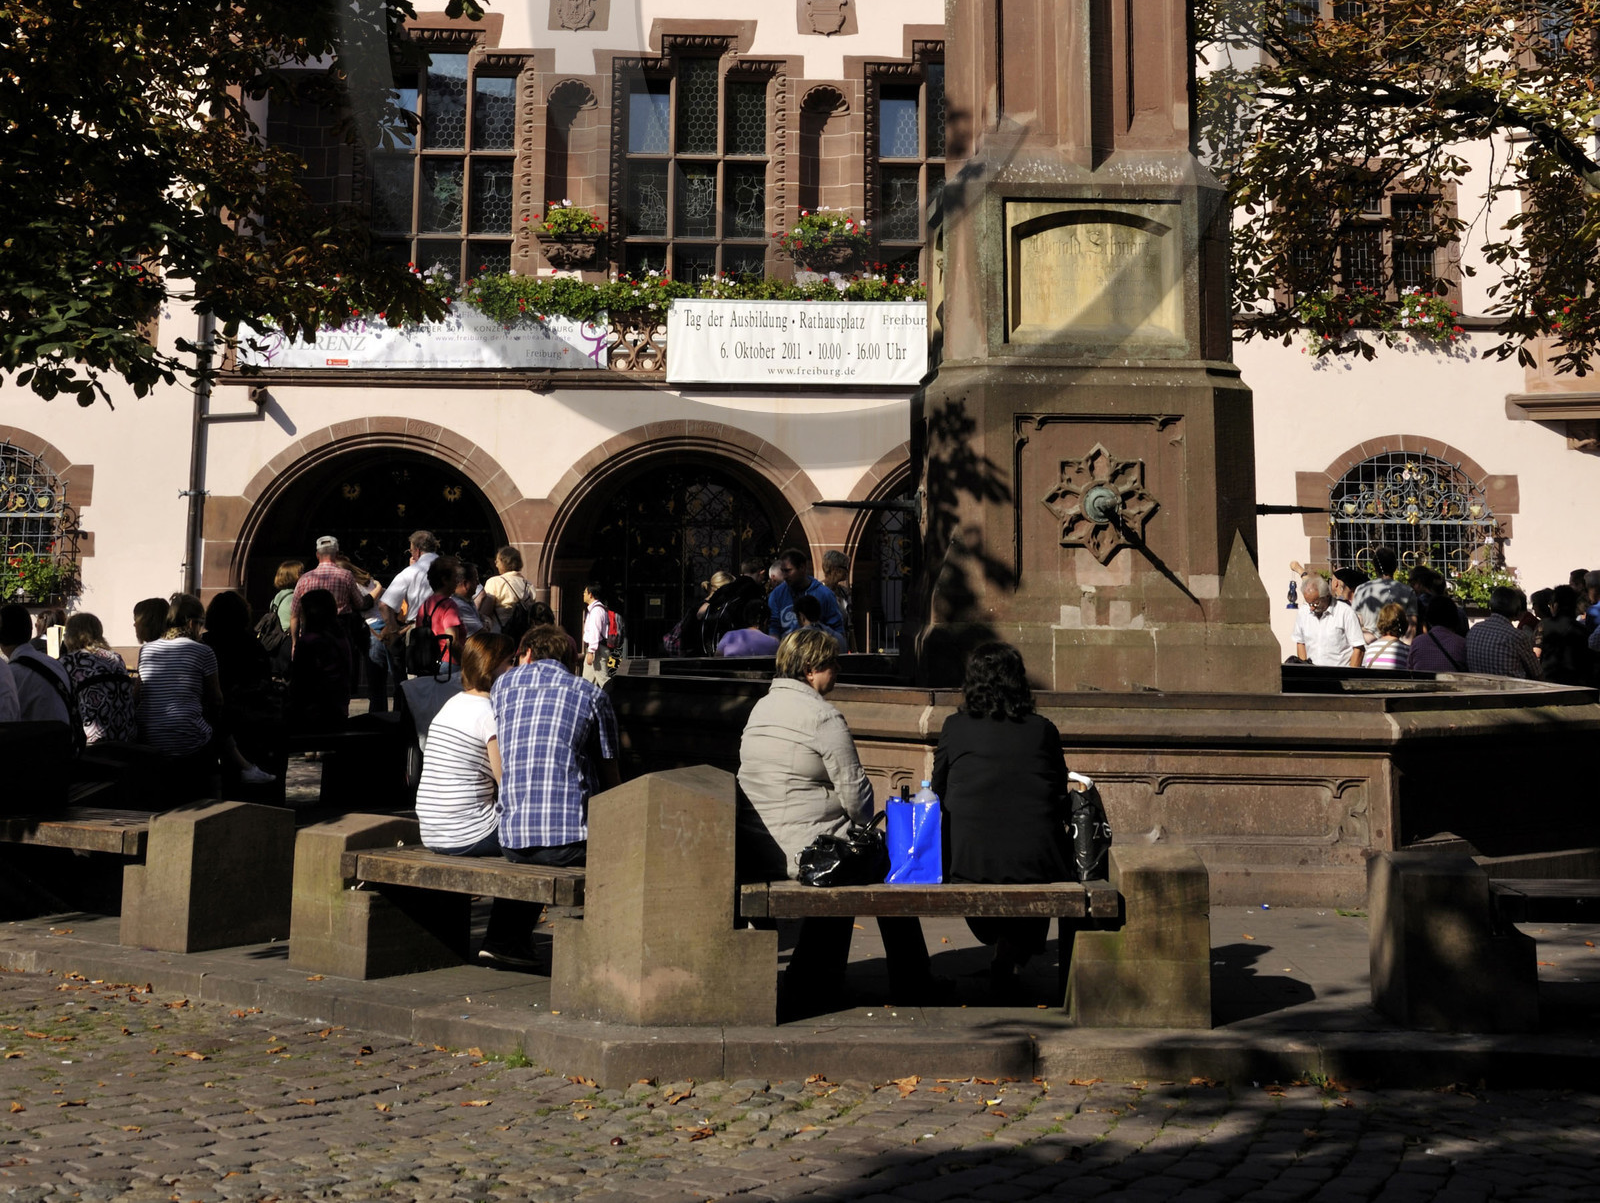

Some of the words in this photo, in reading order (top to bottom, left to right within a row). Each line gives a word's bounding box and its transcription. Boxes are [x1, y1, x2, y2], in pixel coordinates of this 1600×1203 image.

[683, 309, 702, 331] Tag
[707, 310, 724, 328] der
[730, 310, 788, 333] Ausbildung
[799, 311, 865, 333] Rathausplatz
[882, 314, 928, 328] Freibur
[525, 349, 562, 360] Freiburg
[720, 342, 729, 359] 6.
[734, 341, 776, 360] Oktober
[781, 342, 801, 360] 2011
[818, 342, 842, 360] 10.00
[857, 342, 881, 360] 16.00
[887, 342, 907, 360] Uhr
[767, 366, 856, 377] www.freiburg.de
